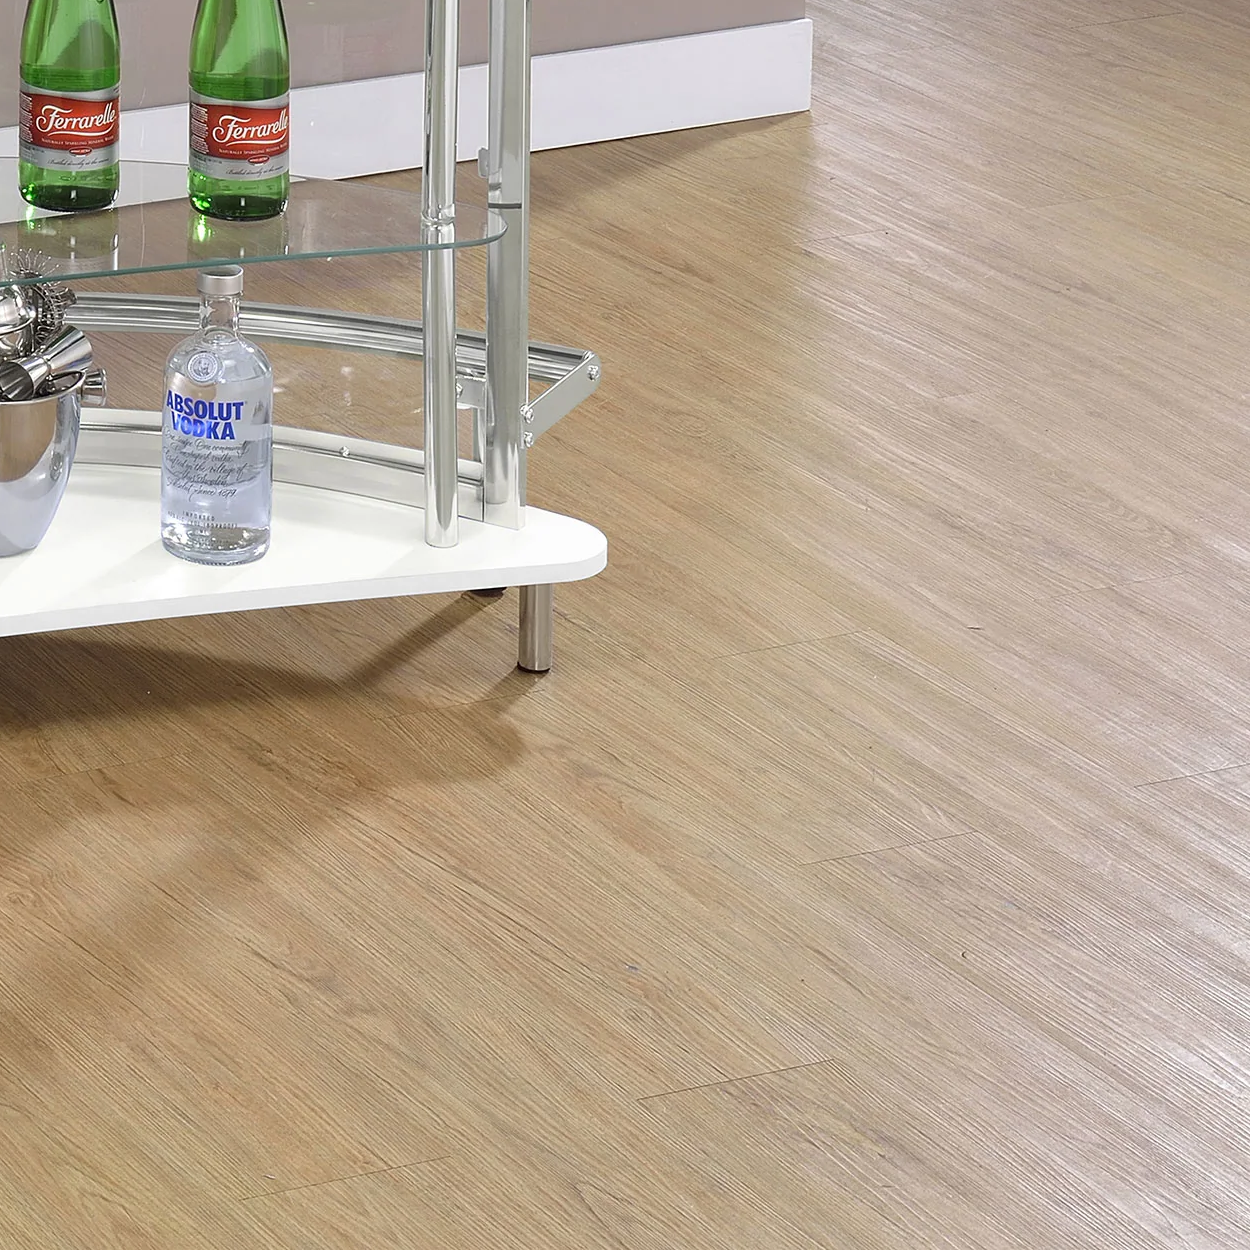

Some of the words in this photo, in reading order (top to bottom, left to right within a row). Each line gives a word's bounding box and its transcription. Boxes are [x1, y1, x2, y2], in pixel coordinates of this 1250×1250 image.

[35, 101, 116, 133] Ferrarelle
[166, 389, 245, 421] ABSOLUT
[171, 410, 236, 441] VODKA
